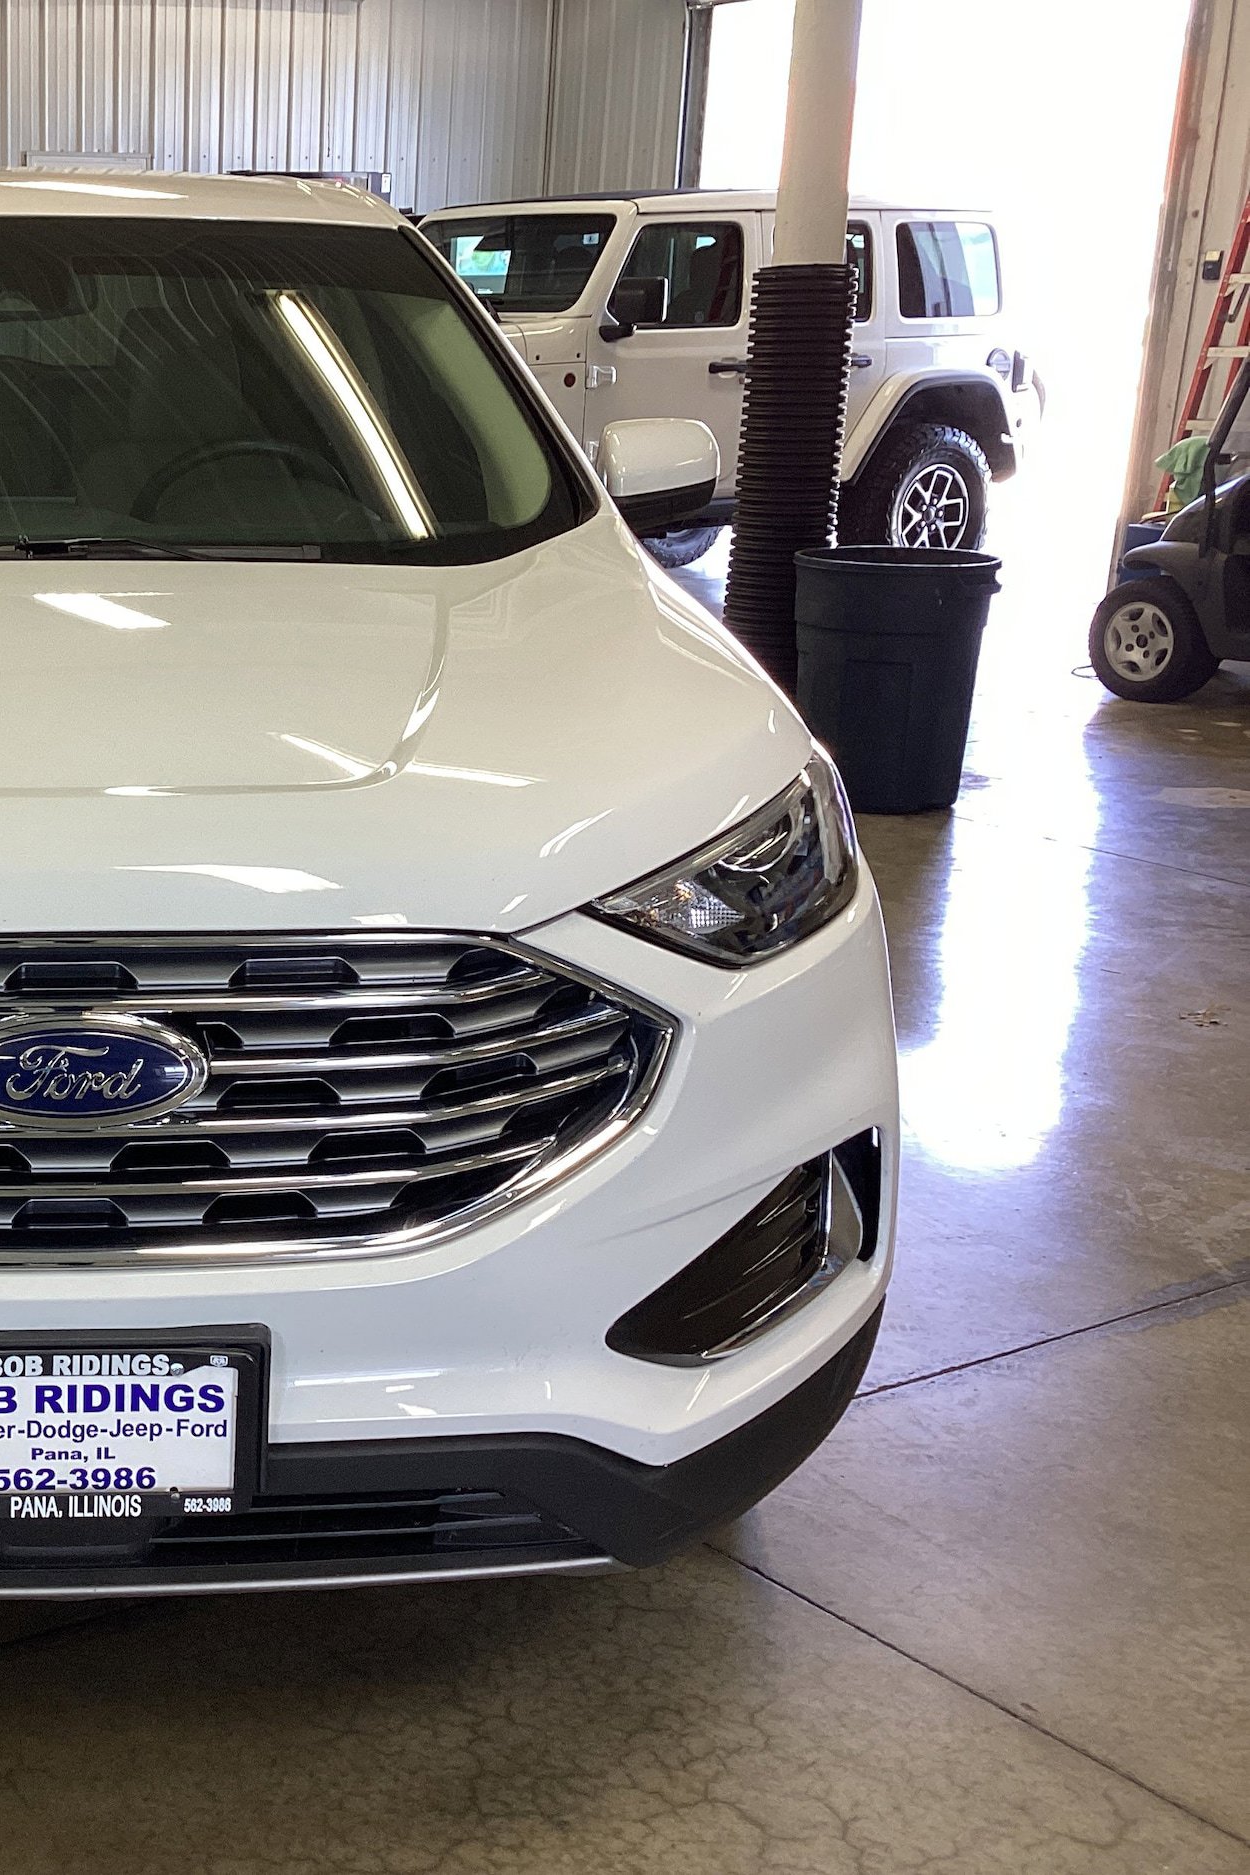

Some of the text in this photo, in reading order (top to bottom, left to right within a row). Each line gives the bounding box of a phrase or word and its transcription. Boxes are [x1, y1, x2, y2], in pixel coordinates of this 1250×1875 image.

[5, 1043, 145, 1101] Ford
[52, 1353, 170, 1377] RIDINGS
[34, 1383, 226, 1414] RIDINGS
[30, 1446, 116, 1463] Pana, IL
[10, 1494, 142, 1519] PANA, ILLINOIS
[183, 1497, 232, 1513] 562-3986
